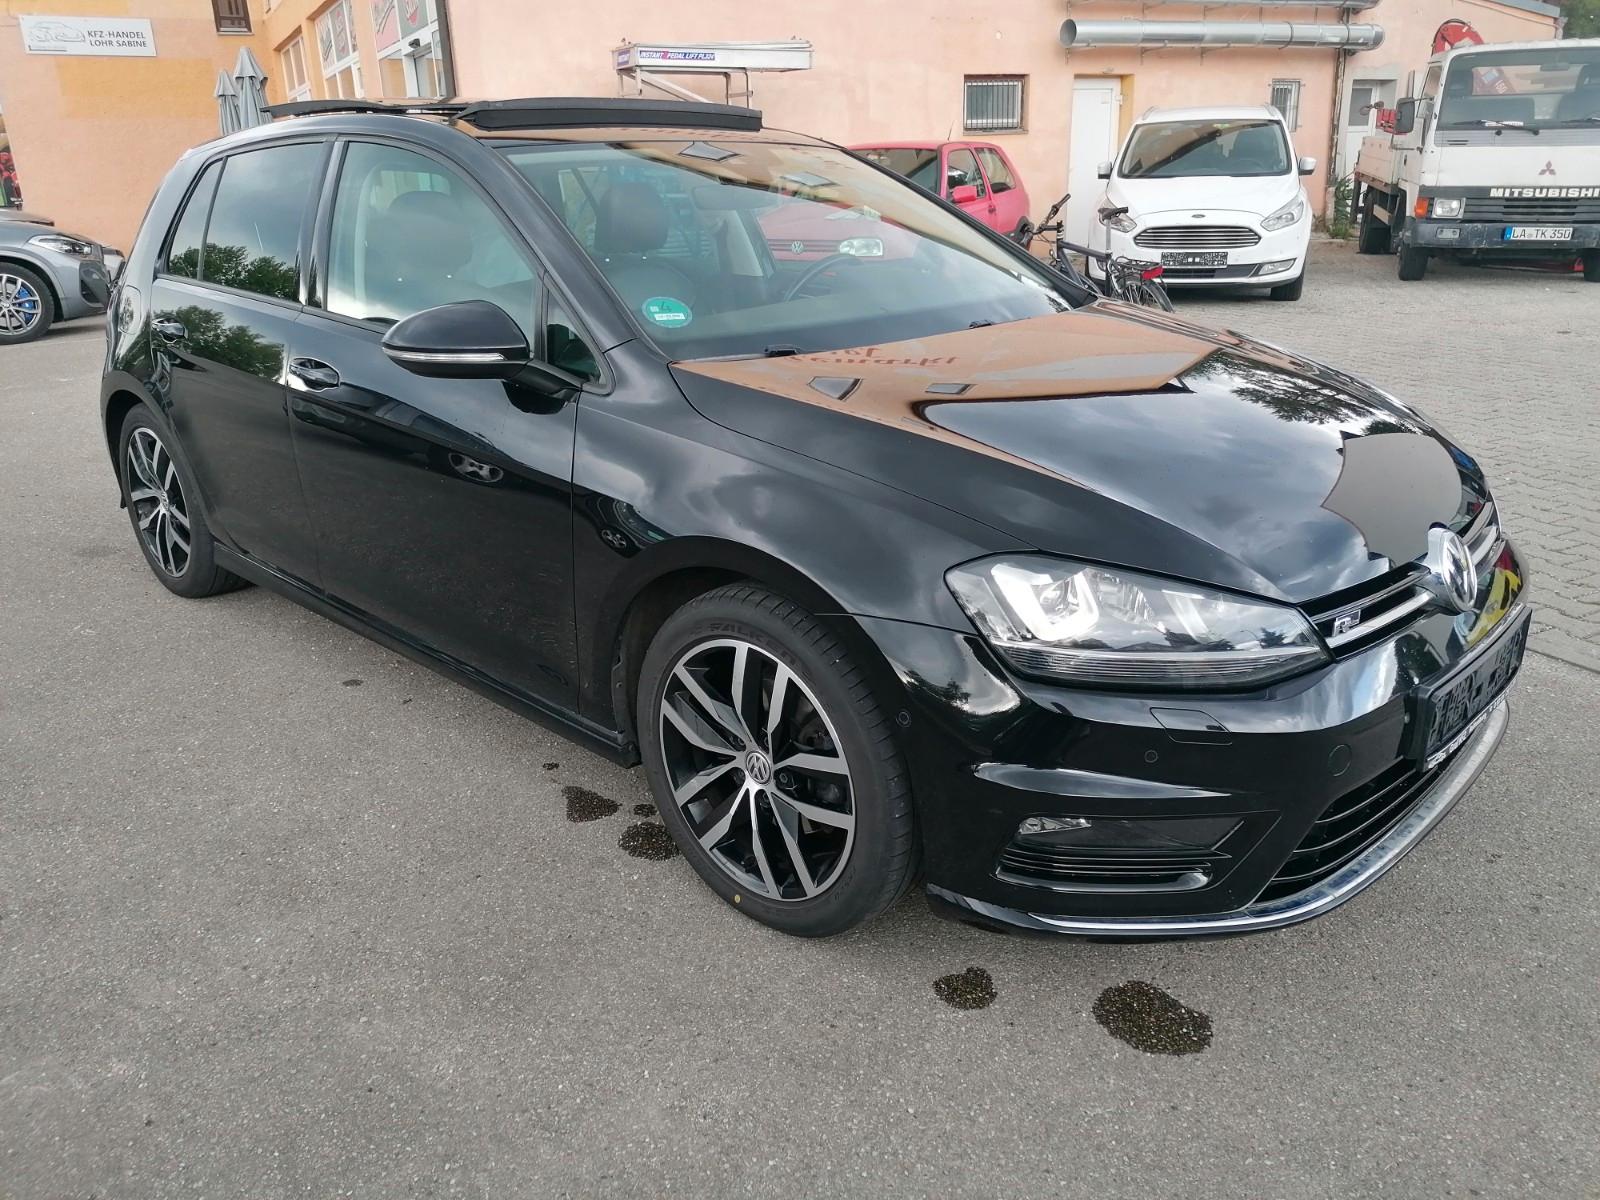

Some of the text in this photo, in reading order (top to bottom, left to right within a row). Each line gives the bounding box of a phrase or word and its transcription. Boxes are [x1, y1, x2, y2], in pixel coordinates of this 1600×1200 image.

[87, 30, 146, 39] KFZ-HANDEL
[90, 39, 148, 48] LOHR SABINE
[1490, 188, 1600, 198] MITSUBISHI
[1512, 228, 1571, 239] LA TK 350
